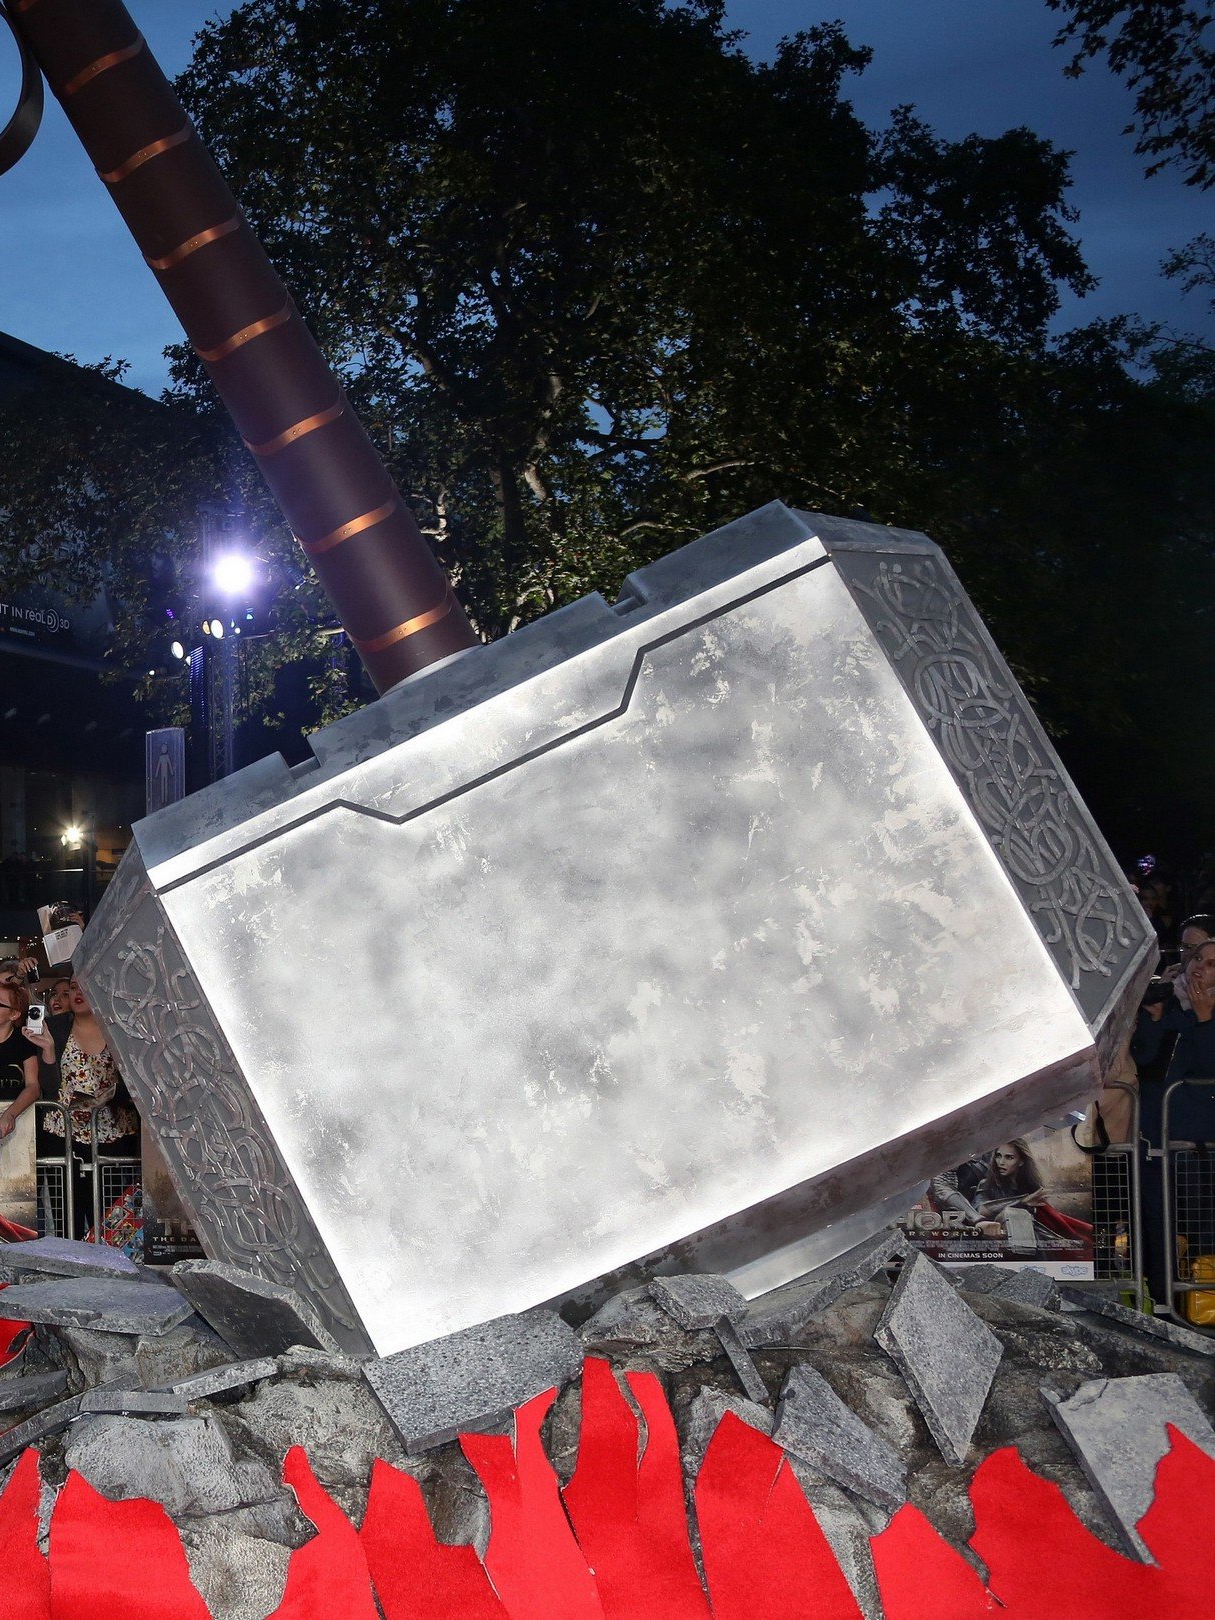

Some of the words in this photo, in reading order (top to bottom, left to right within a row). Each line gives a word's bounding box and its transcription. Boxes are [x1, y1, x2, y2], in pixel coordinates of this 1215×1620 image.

[0, 603, 9, 615] IT
[11, 606, 23, 619] IN
[60, 619, 70, 630] 3D
[1061, 1265, 1089, 1277] skype
